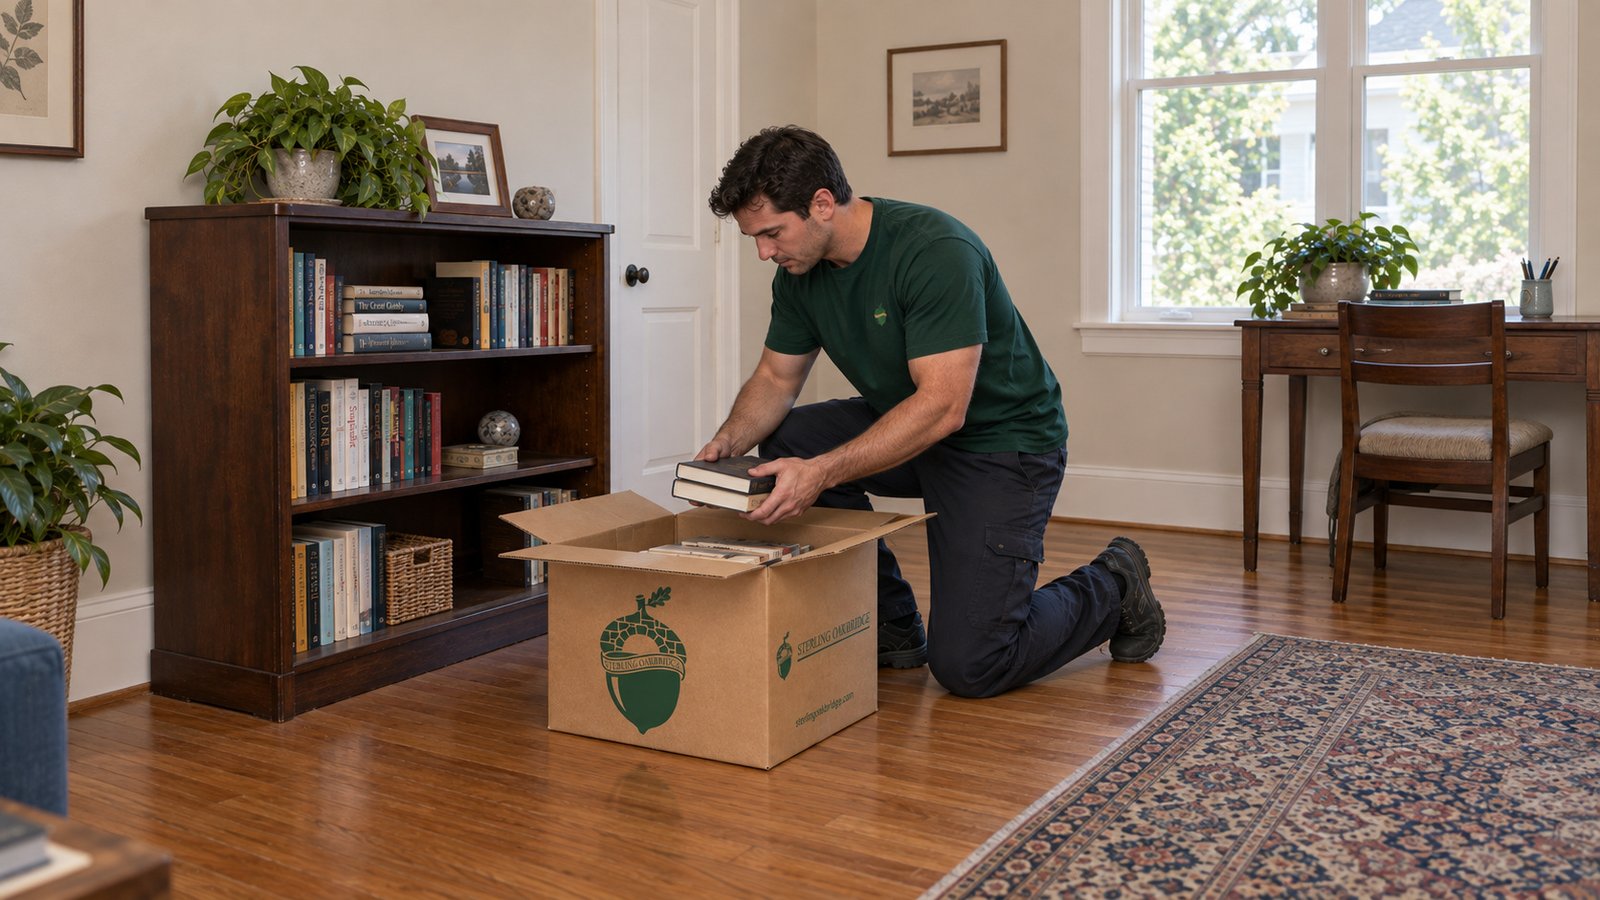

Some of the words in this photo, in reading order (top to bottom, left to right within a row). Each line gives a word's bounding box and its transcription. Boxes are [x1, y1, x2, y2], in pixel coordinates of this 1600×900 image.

[797, 631, 832, 656] STERLING
[832, 611, 871, 640] OAKBRIDGE
[605, 659, 638, 671] STERLING
[638, 656, 682, 669] OAKBRIDGE
[795, 692, 854, 728] sterlingoakbridge.com
